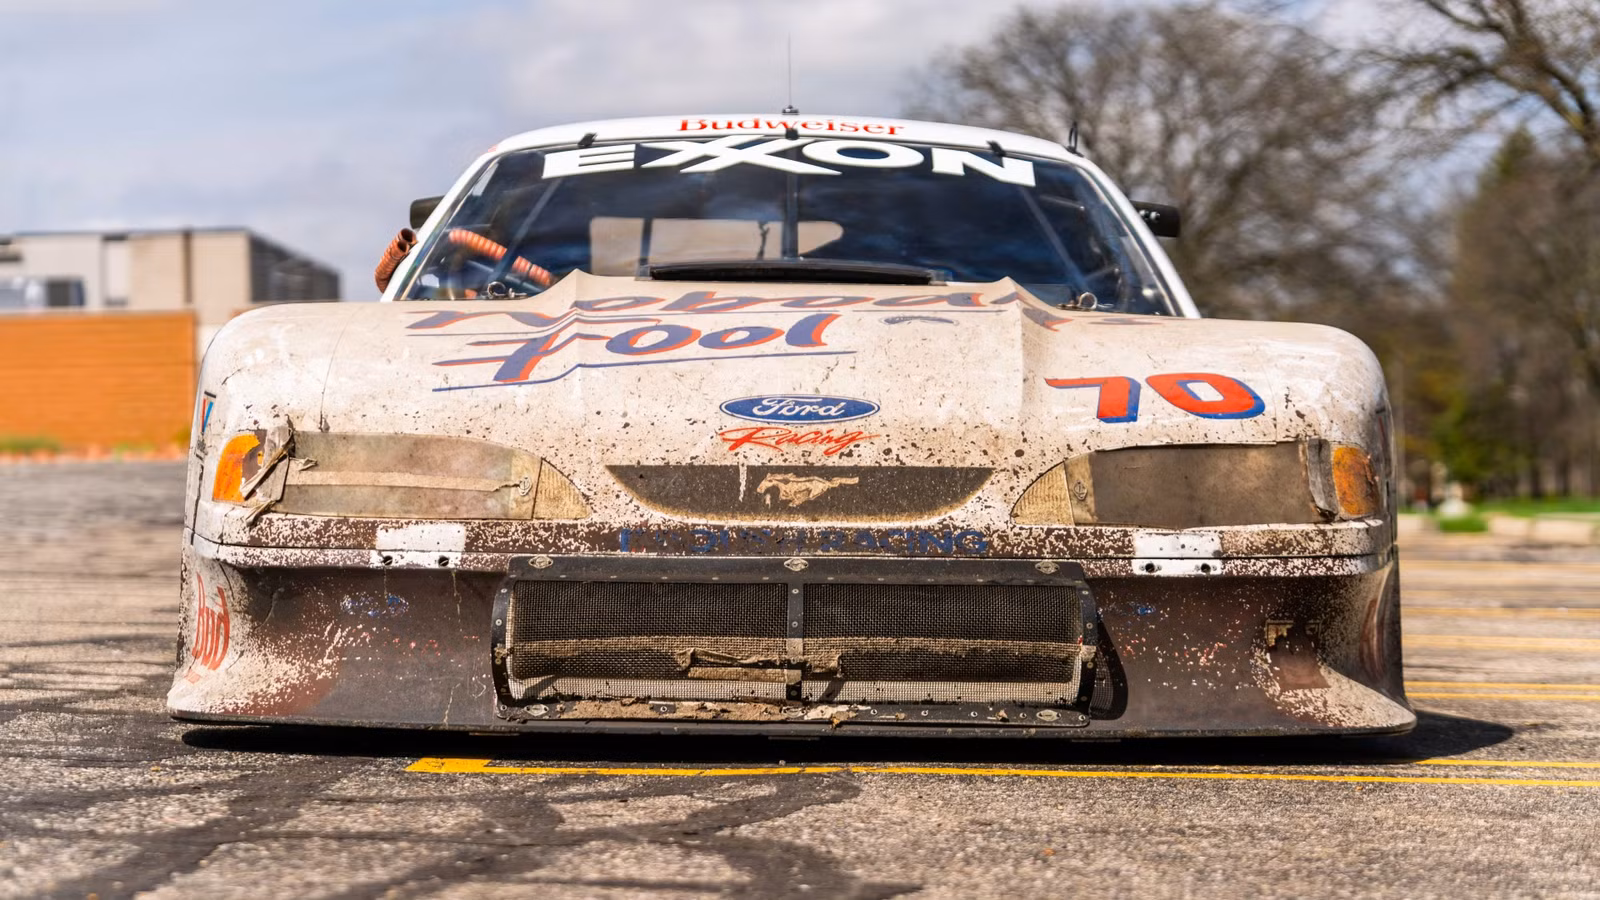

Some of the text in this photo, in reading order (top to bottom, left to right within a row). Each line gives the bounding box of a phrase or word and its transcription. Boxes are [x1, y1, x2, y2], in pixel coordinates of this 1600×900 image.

[677, 117, 905, 136] Budweiser
[541, 134, 1037, 188] EXXON
[752, 397, 847, 417] Ford
[1043, 372, 1266, 424] 70
[718, 426, 881, 456] Racing
